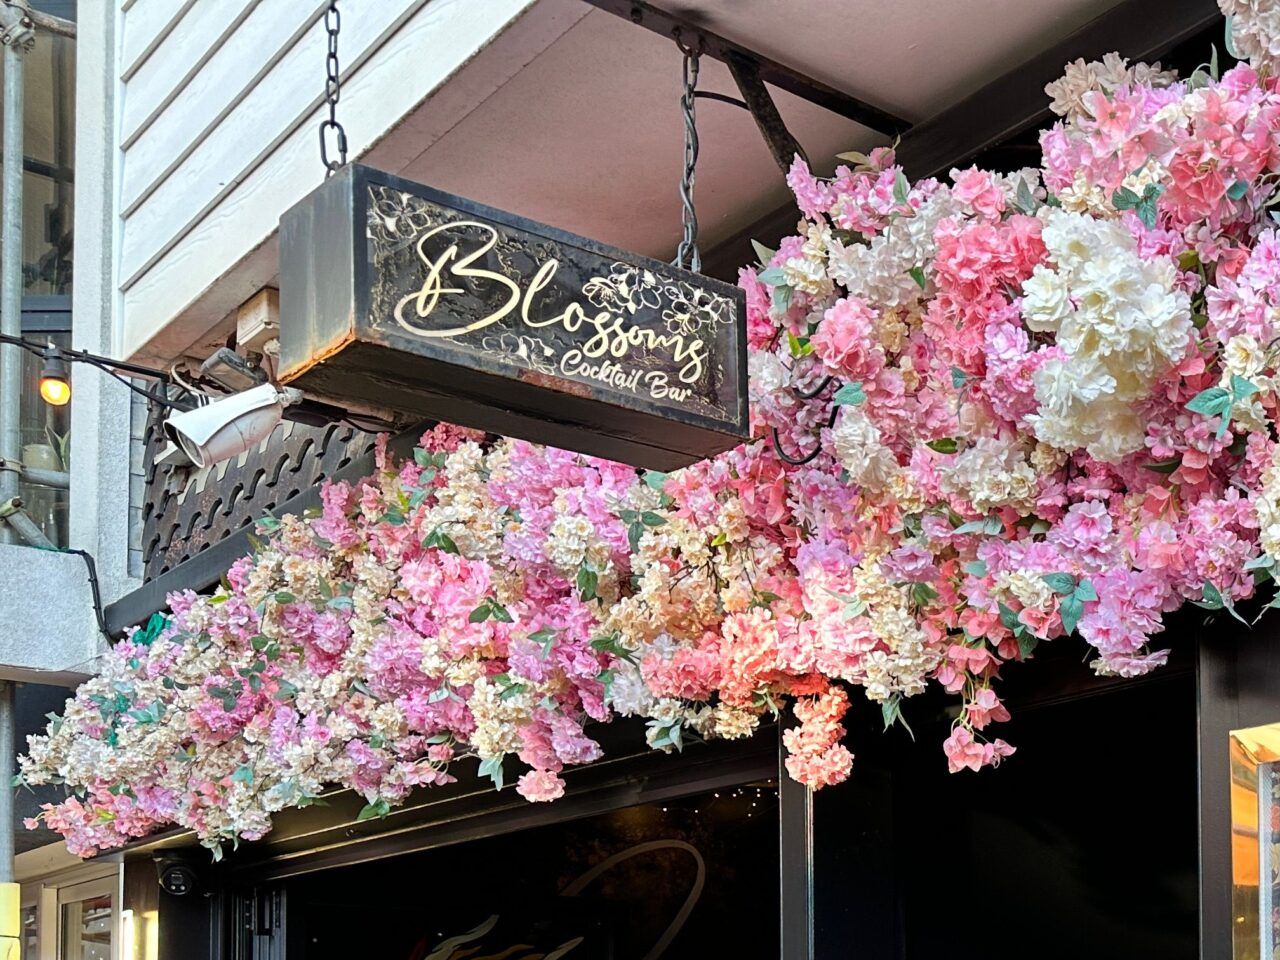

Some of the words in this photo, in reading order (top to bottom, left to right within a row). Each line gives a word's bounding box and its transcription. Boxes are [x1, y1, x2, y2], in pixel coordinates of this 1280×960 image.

[393, 220, 709, 384] Blossoms
[560, 349, 643, 393] Cocktail
[644, 370, 693, 403] Bar
